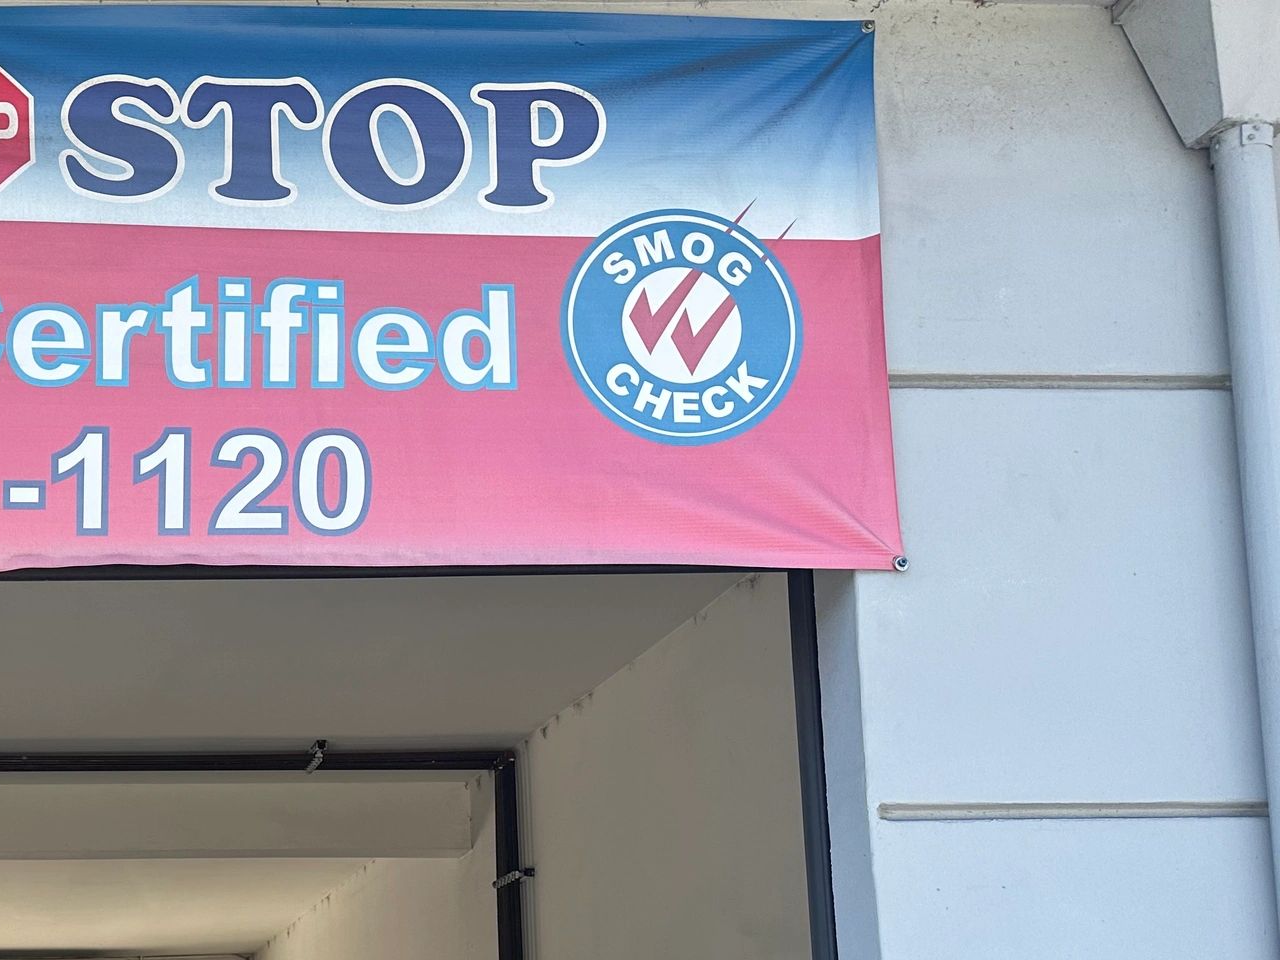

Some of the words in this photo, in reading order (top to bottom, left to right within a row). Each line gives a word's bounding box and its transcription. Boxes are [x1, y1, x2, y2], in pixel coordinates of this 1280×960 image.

[58, 73, 608, 214] STOP
[602, 228, 753, 287] SMOG
[606, 359, 770, 424] CHECK
